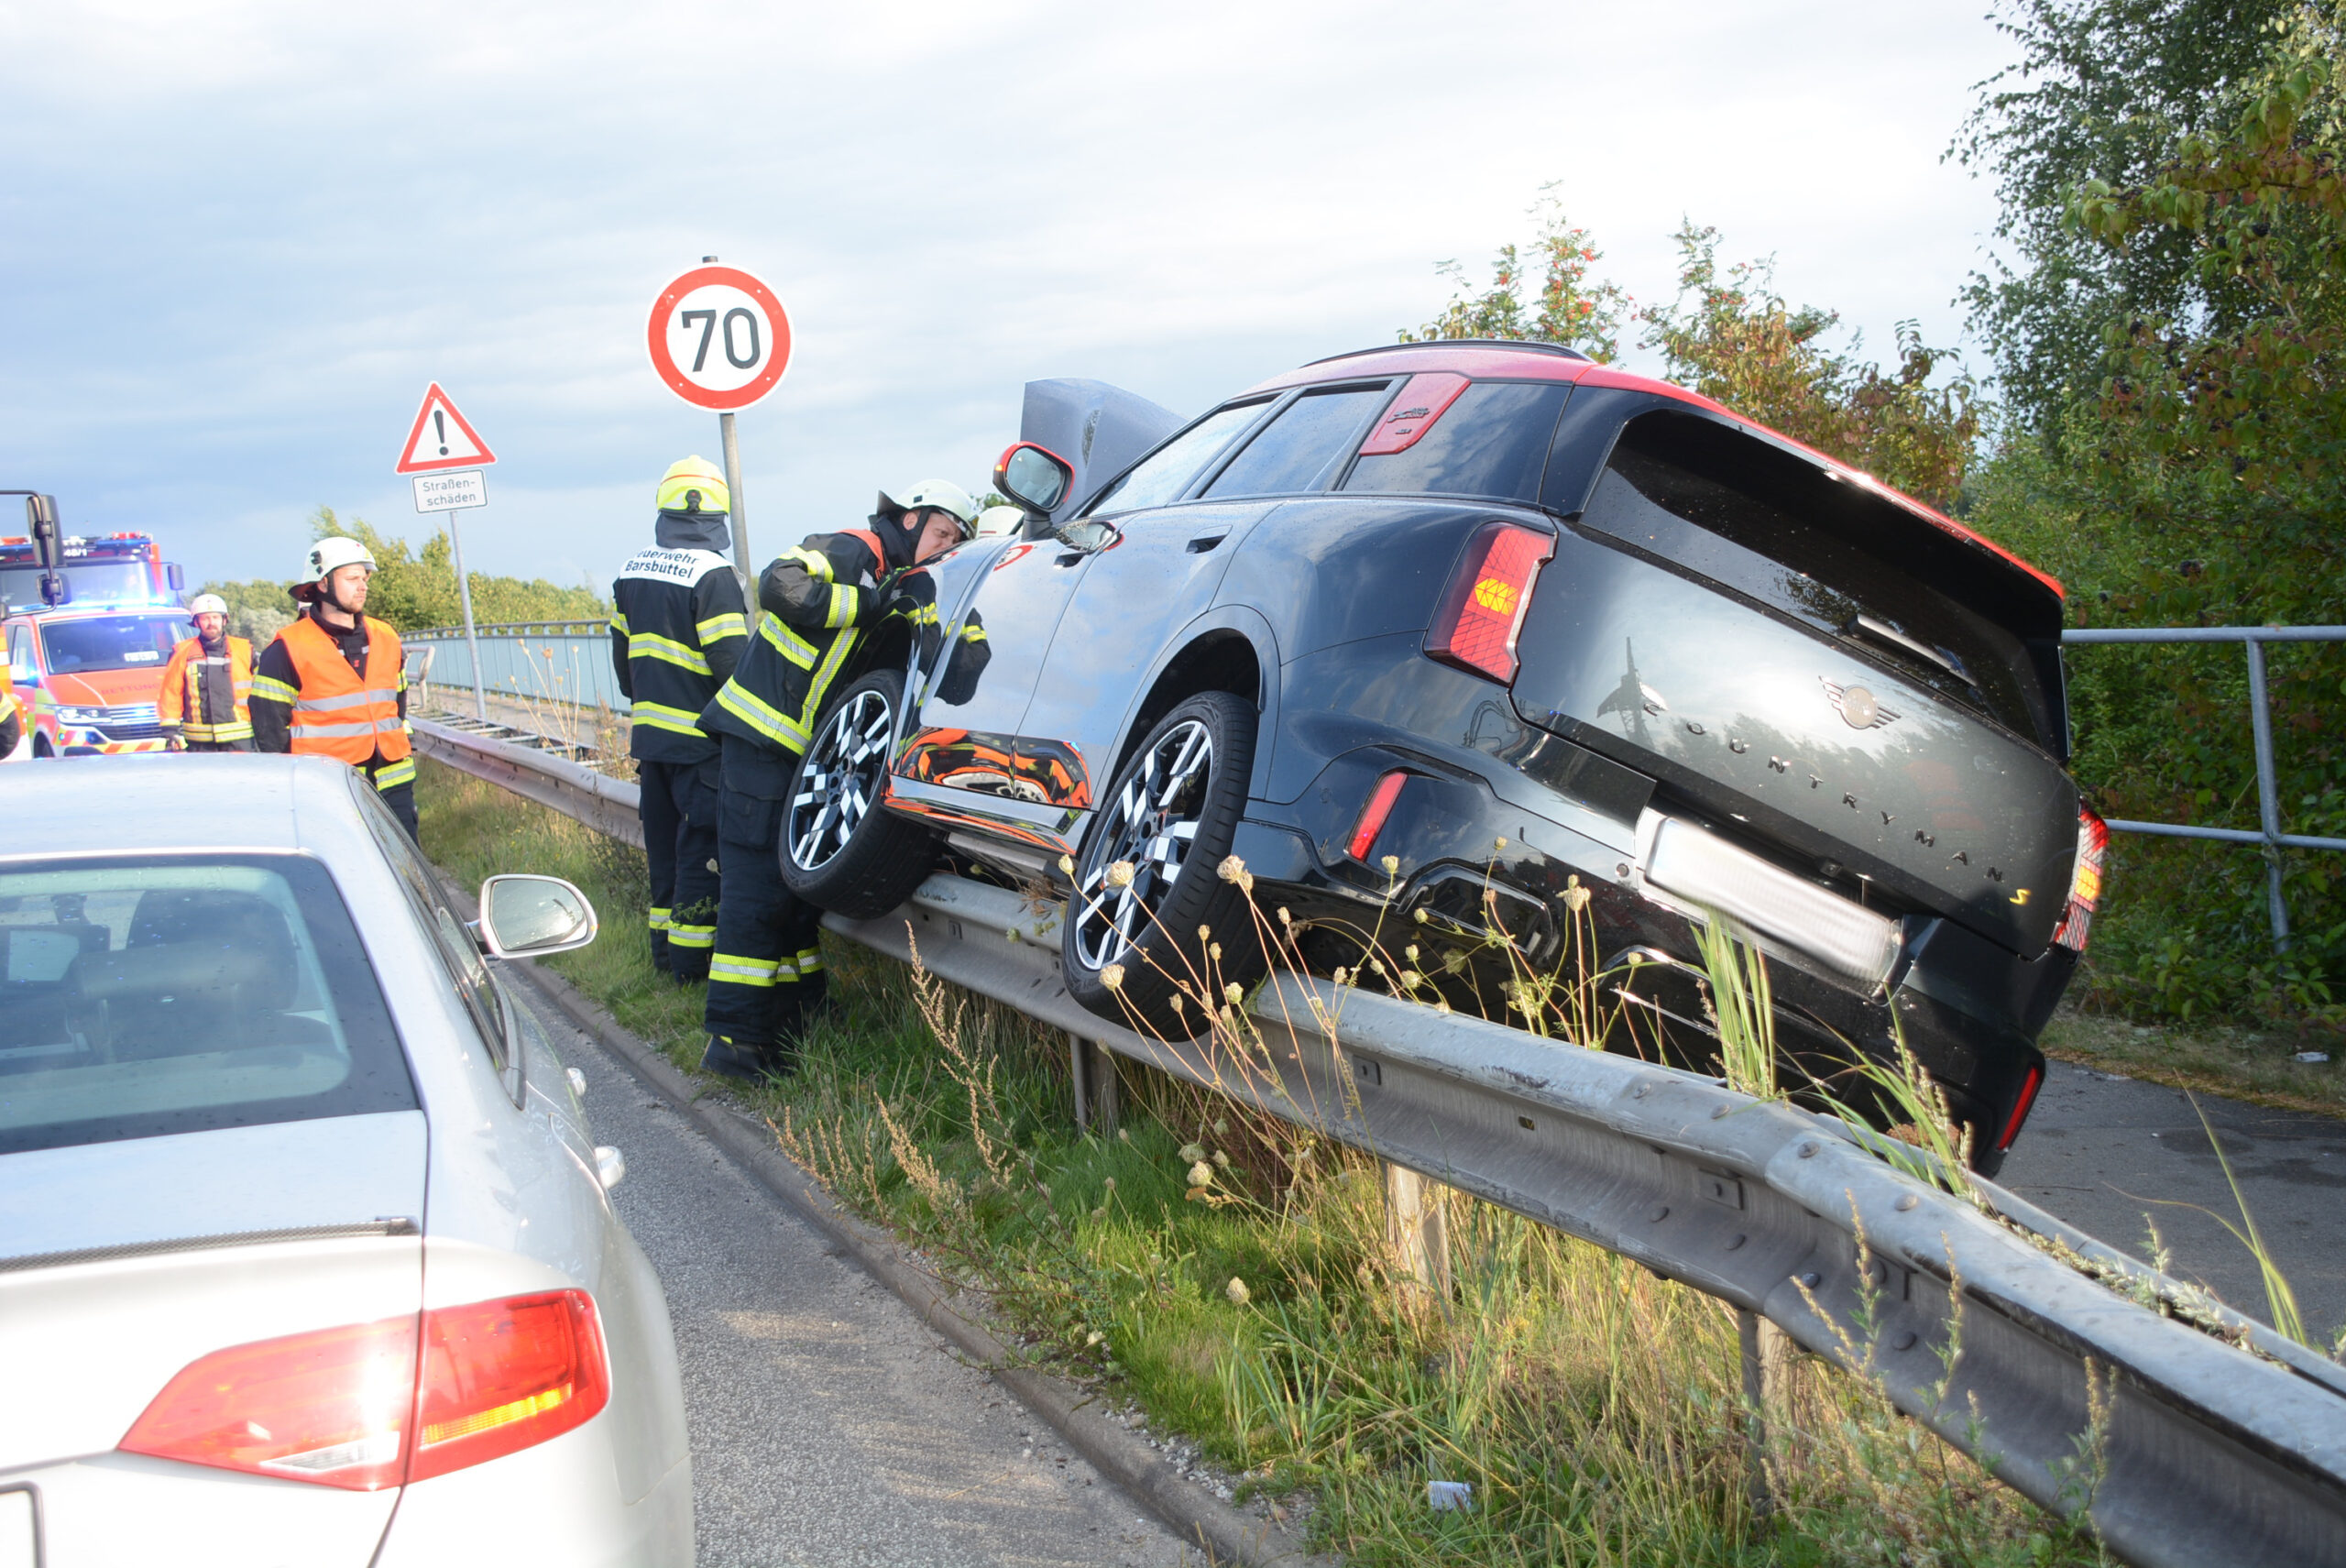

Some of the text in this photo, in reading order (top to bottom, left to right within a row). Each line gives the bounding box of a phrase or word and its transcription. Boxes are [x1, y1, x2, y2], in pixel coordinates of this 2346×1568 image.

[681, 307, 761, 372] 70
[422, 478, 476, 492] Straßen-
[426, 493, 477, 506] schäden
[637, 550, 699, 565] euerwehr
[625, 559, 694, 578] Barsbüttel
[101, 682, 161, 696] RETTUNG
[1643, 701, 2032, 906] COUNTRYMAN S
